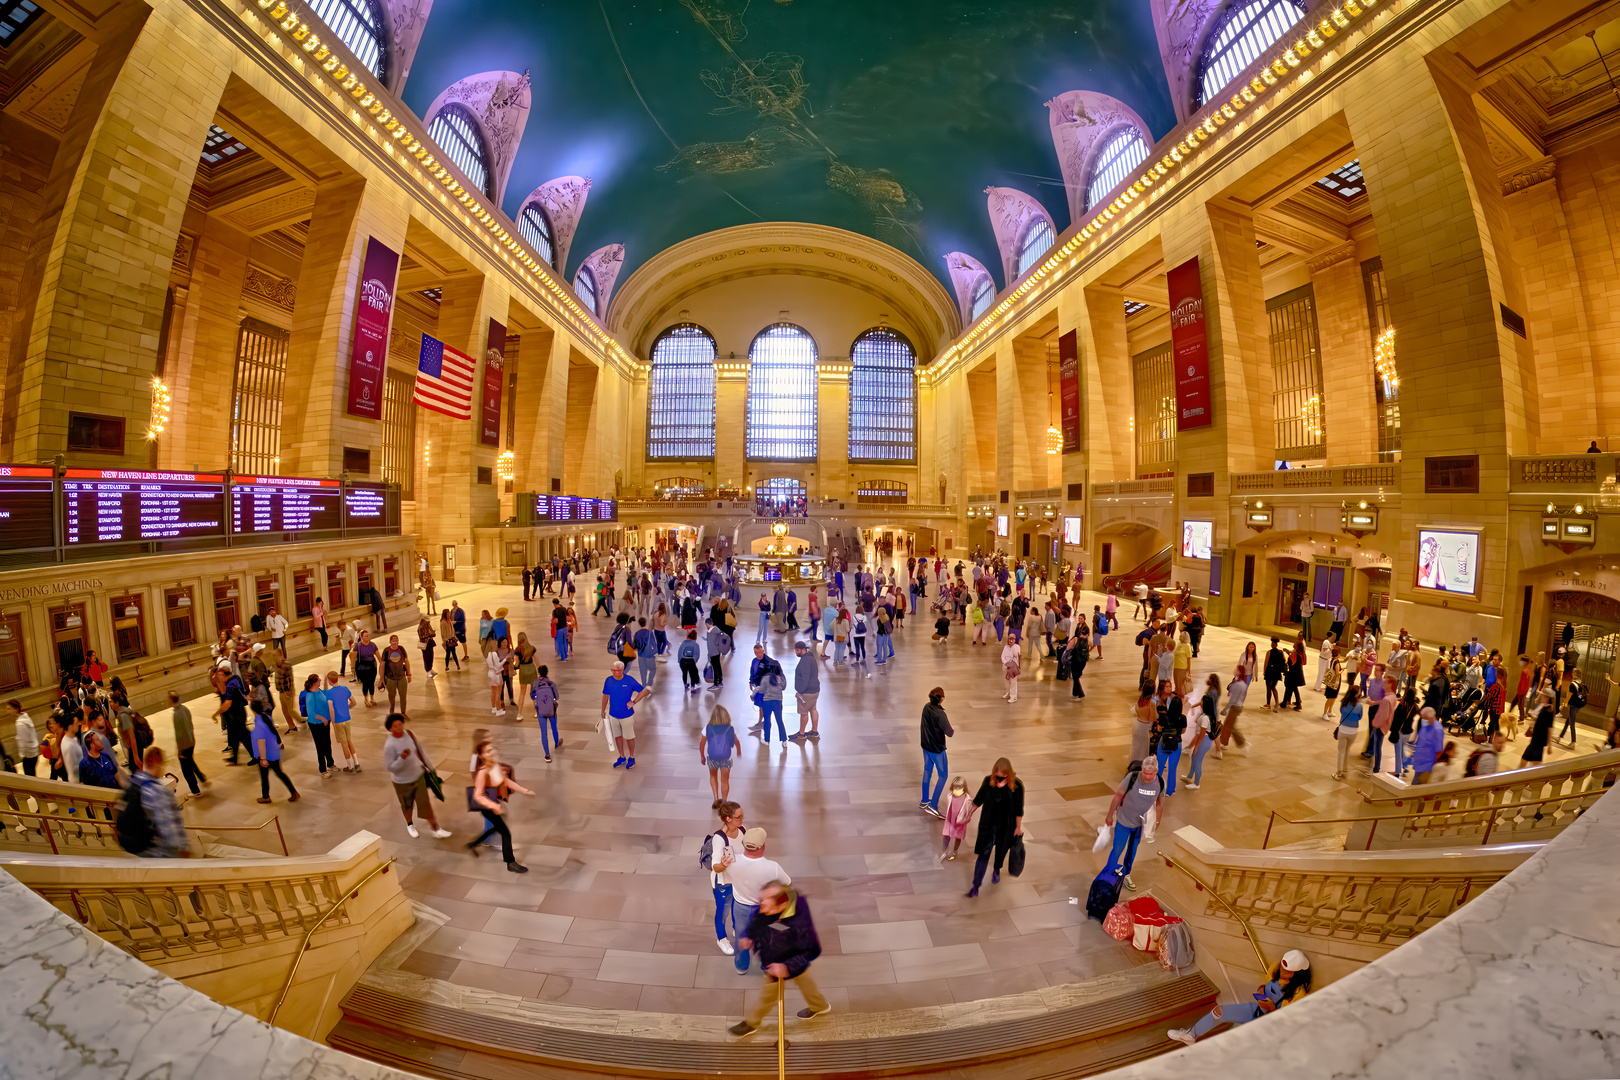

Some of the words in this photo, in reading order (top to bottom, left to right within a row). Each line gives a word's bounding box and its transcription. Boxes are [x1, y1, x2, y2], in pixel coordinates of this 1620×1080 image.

[363, 280, 391, 304] HOLIDAY
[368, 296, 383, 313] FAIR
[1172, 299, 1201, 322] HOLIDAY
[1180, 314, 1196, 328] FAIR
[52, 579, 102, 593] MACHINES
[1572, 579, 1596, 588] TRACK
